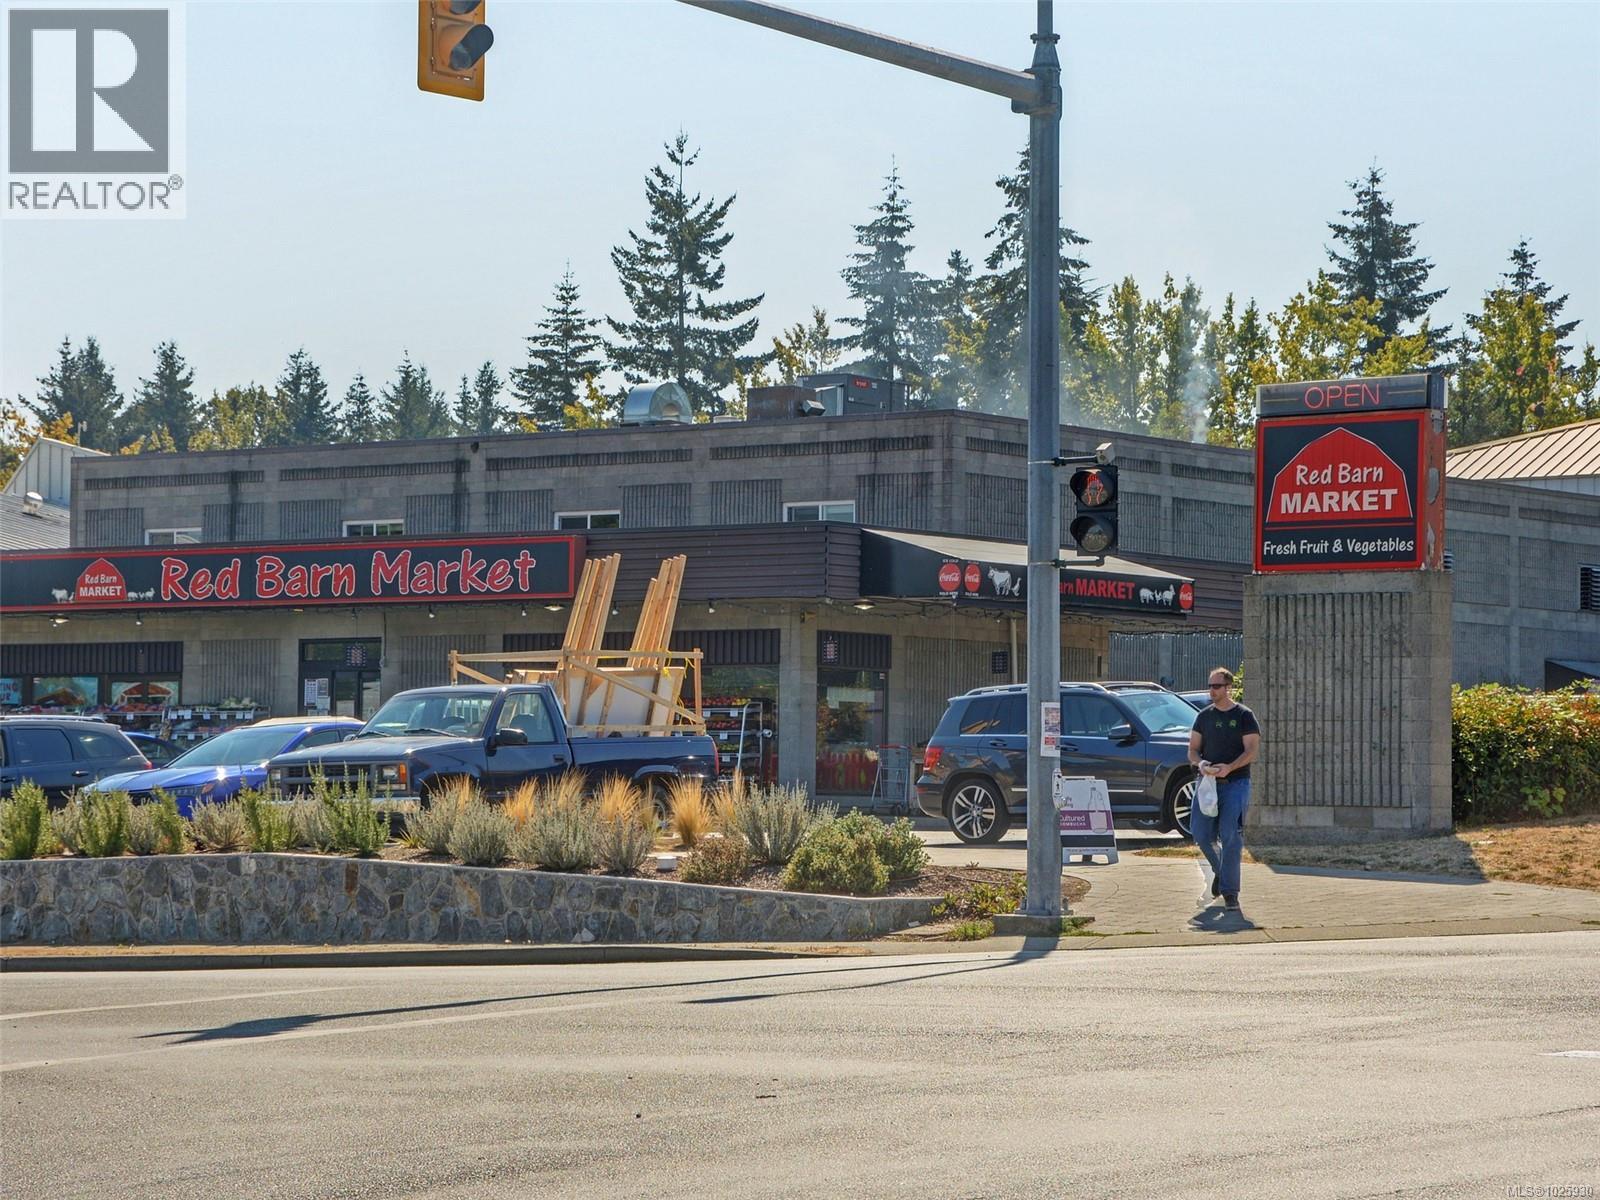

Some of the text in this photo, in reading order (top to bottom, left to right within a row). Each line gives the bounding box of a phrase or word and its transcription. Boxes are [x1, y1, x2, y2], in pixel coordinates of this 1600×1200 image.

[1304, 383, 1380, 409] OPEN
[1296, 462, 1383, 486] Red Barn
[1280, 488, 1398, 514] MARKET
[1263, 537, 1414, 556] Fresh Fruit & Vegetables
[85, 574, 117, 584] Red Barn
[161, 549, 536, 601] Red Barn Market
[79, 586, 122, 597] MARKET
[1059, 577, 1136, 600] arn MARKET
